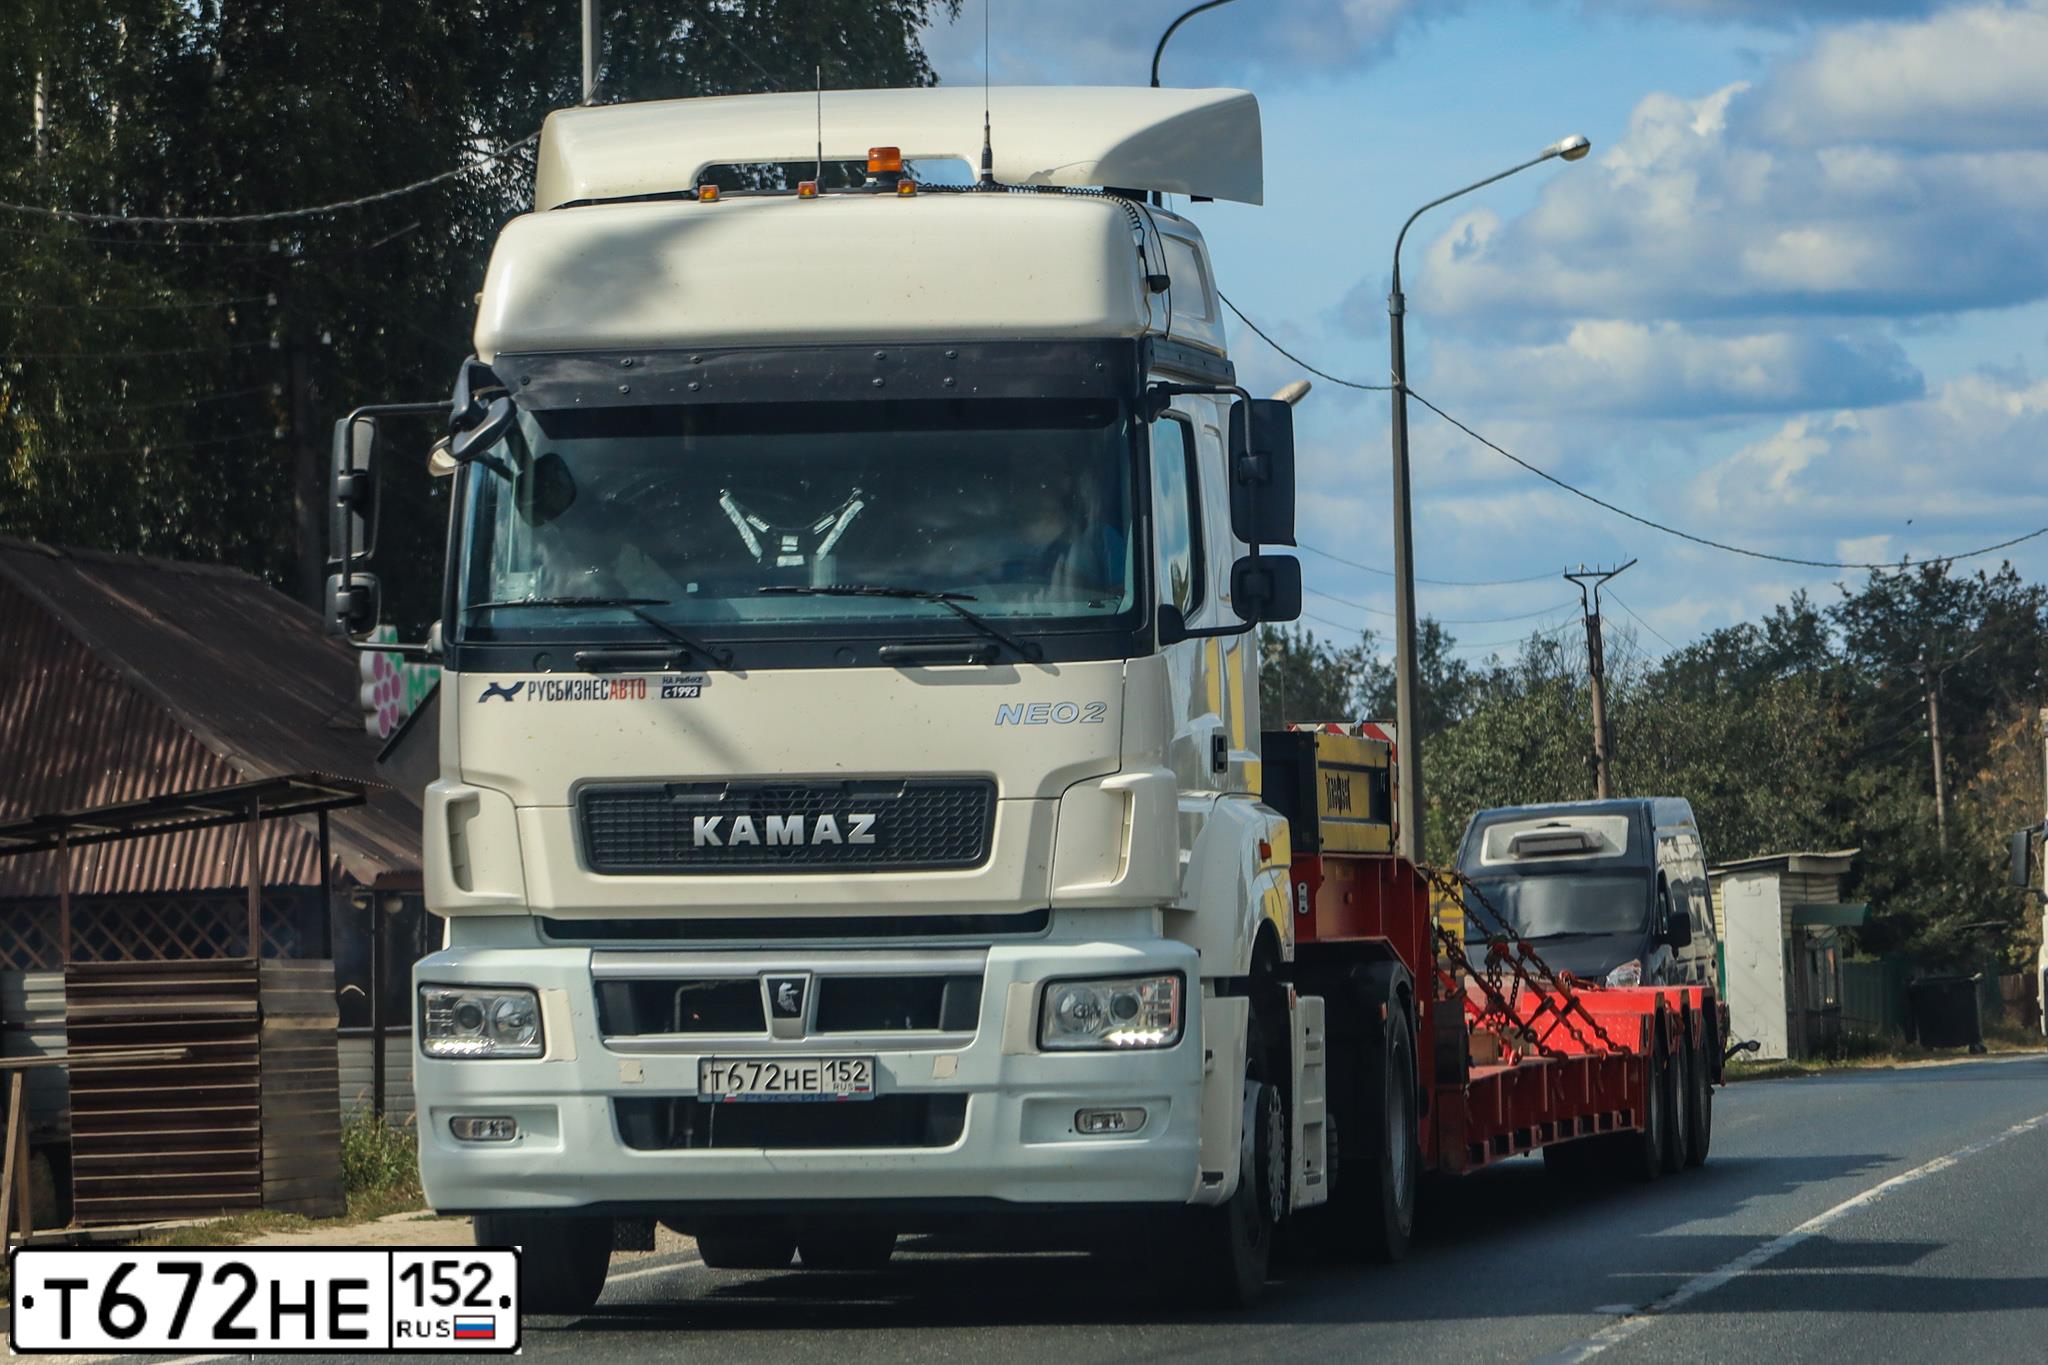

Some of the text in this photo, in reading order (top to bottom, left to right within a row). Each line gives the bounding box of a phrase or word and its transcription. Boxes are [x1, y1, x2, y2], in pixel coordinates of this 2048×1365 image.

[527, 678, 647, 701] РУСБИЗНЕСАВТО
[672, 686, 698, 697] 1993
[994, 701, 1107, 726] NEO2
[692, 814, 876, 846] KAMAZ
[824, 1060, 867, 1083] 152
[833, 1082, 854, 1091] RUS
